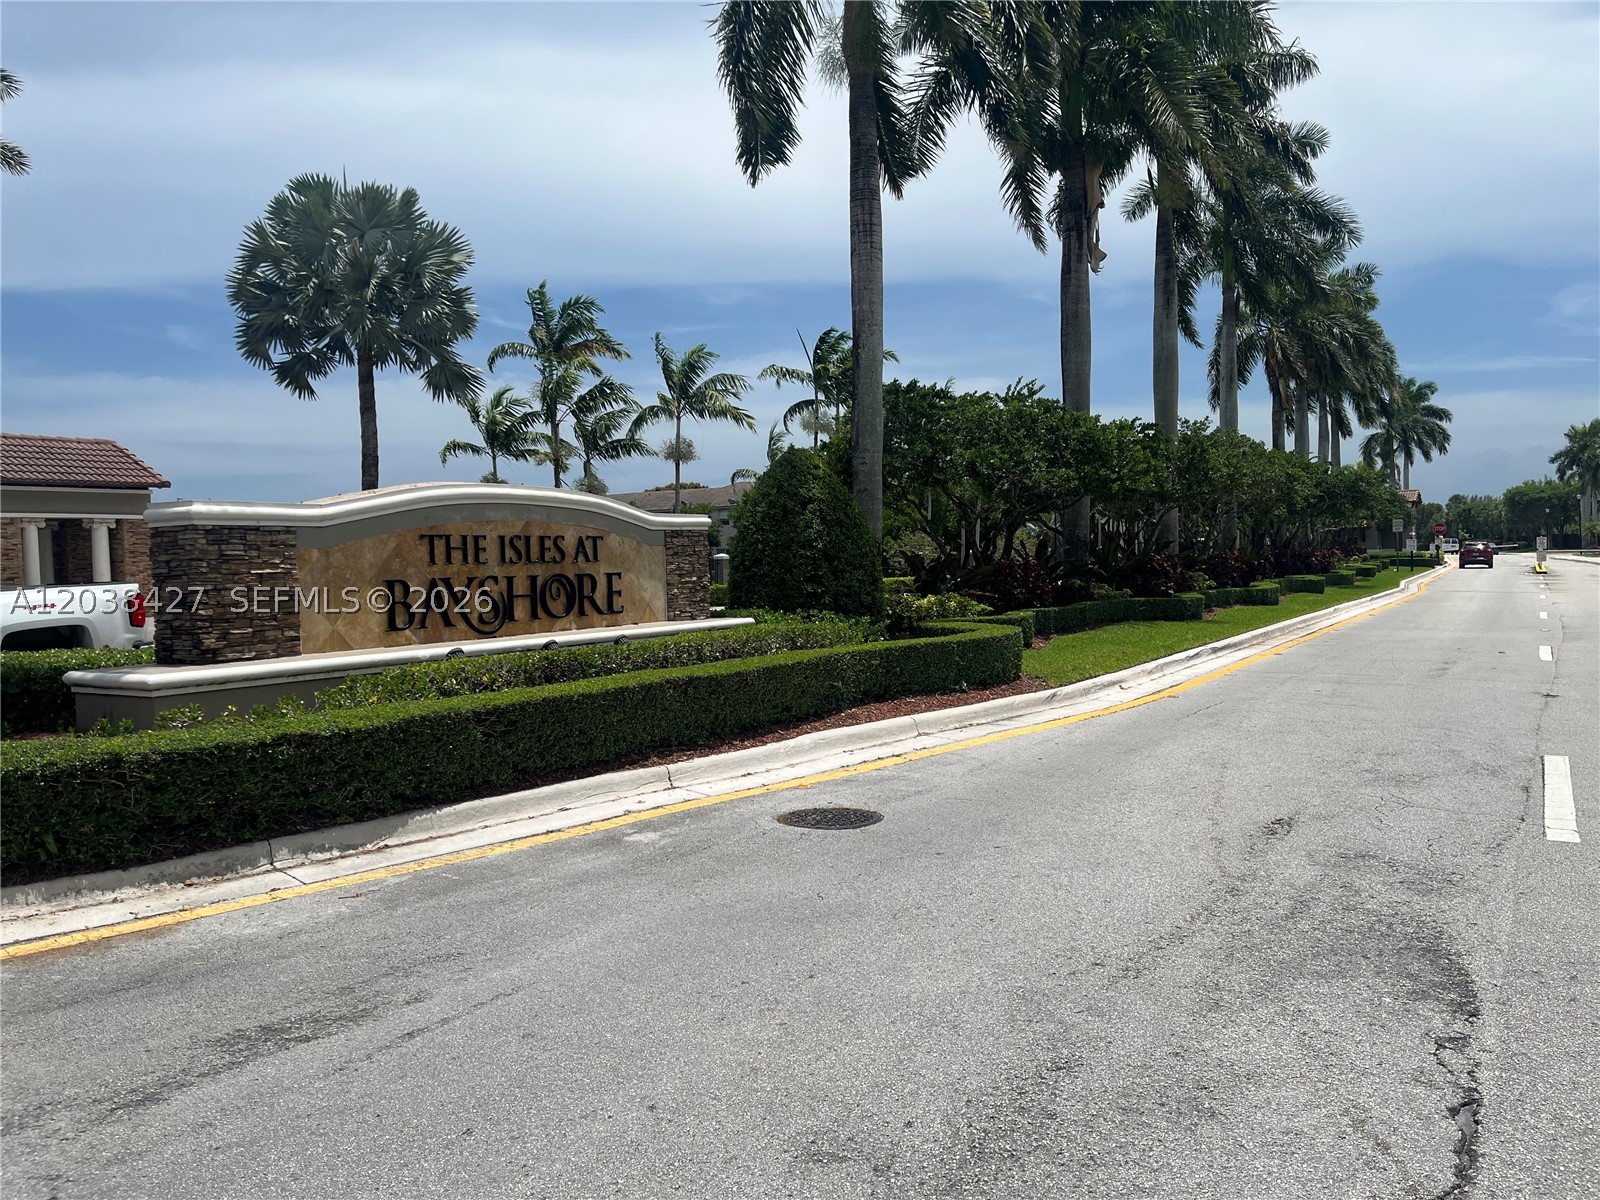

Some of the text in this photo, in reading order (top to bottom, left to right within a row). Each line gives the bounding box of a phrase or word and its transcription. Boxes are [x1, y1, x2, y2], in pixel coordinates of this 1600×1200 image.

[420, 534, 603, 565] THE ISLES AT
[382, 572, 624, 635] BAYSHORE
